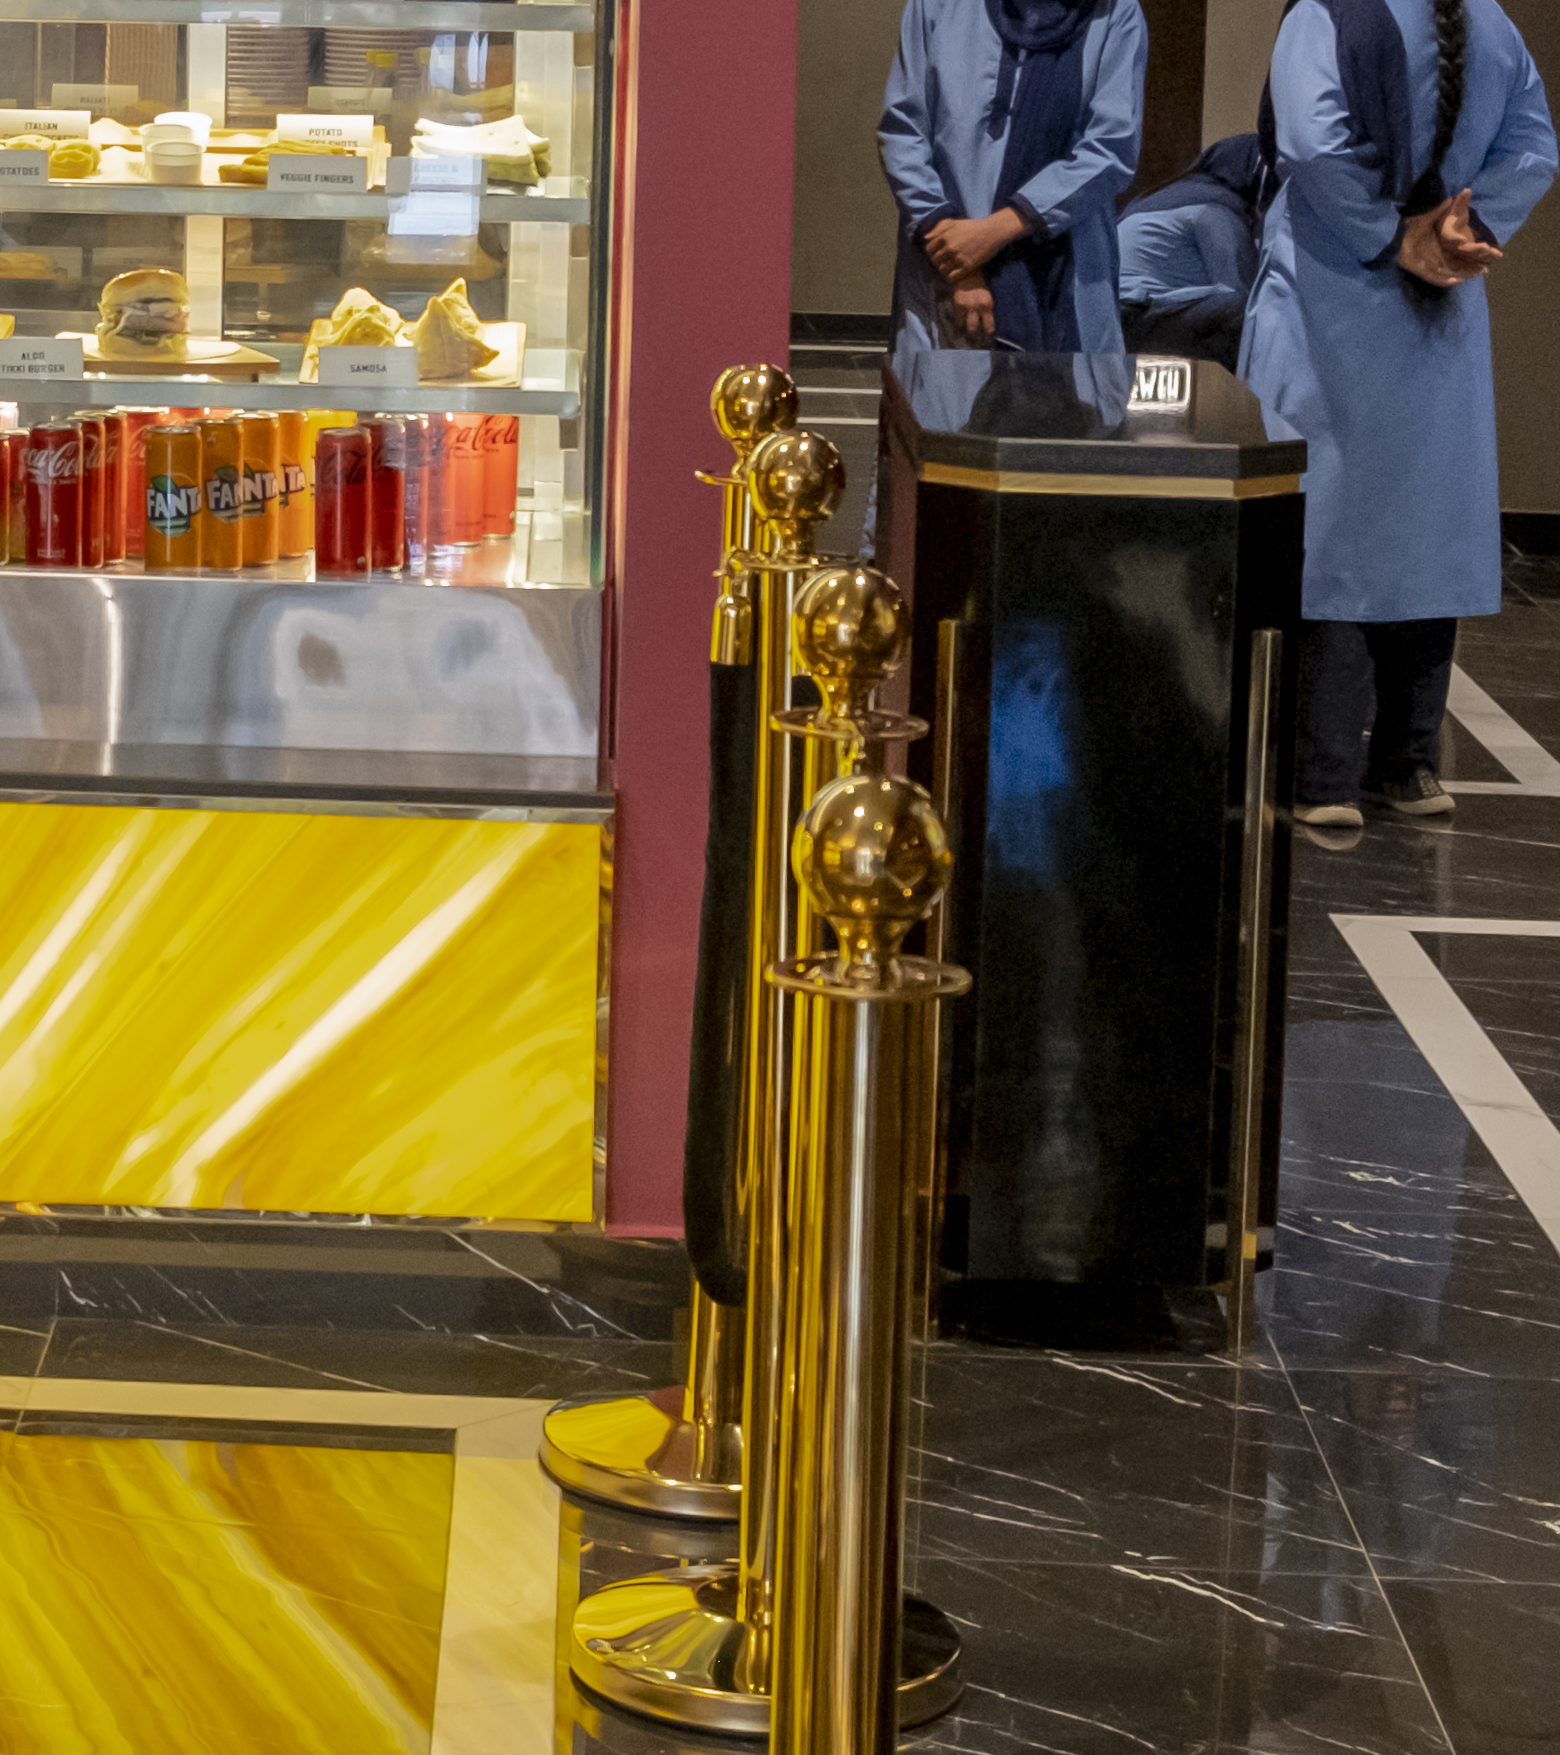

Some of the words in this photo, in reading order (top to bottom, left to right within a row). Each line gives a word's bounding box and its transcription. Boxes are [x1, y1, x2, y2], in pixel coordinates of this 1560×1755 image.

[24, 121, 59, 132] ITALIAN
[308, 128, 343, 137] POTATO
[314, 174, 354, 184] FINGERS
[349, 362, 387, 373] SAMOSA
